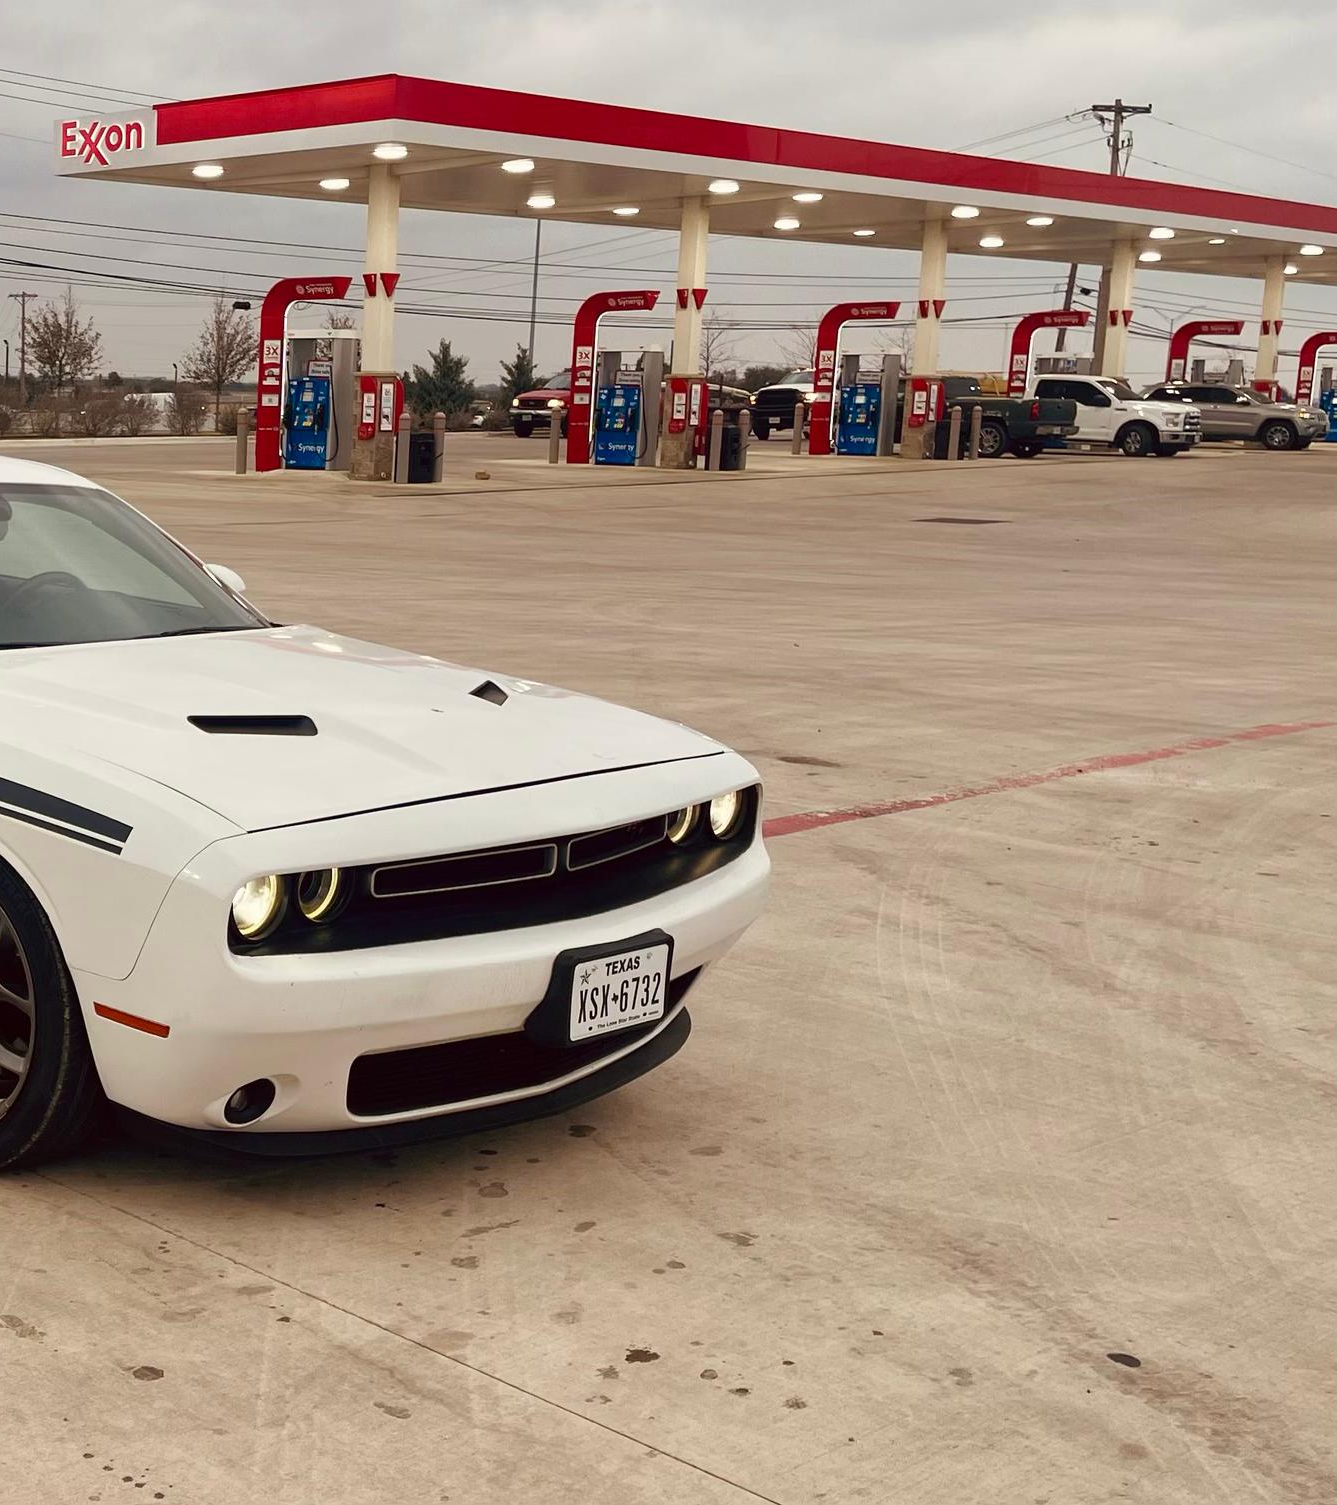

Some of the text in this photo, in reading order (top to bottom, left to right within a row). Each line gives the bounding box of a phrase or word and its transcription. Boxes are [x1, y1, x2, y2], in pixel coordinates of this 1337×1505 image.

[61, 121, 143, 166] Exxon
[305, 285, 334, 295] Synergy
[617, 298, 644, 307] Synergy
[265, 346, 279, 356] 3X
[578, 351, 590, 360] 3X
[605, 956, 641, 977] TEXAS
